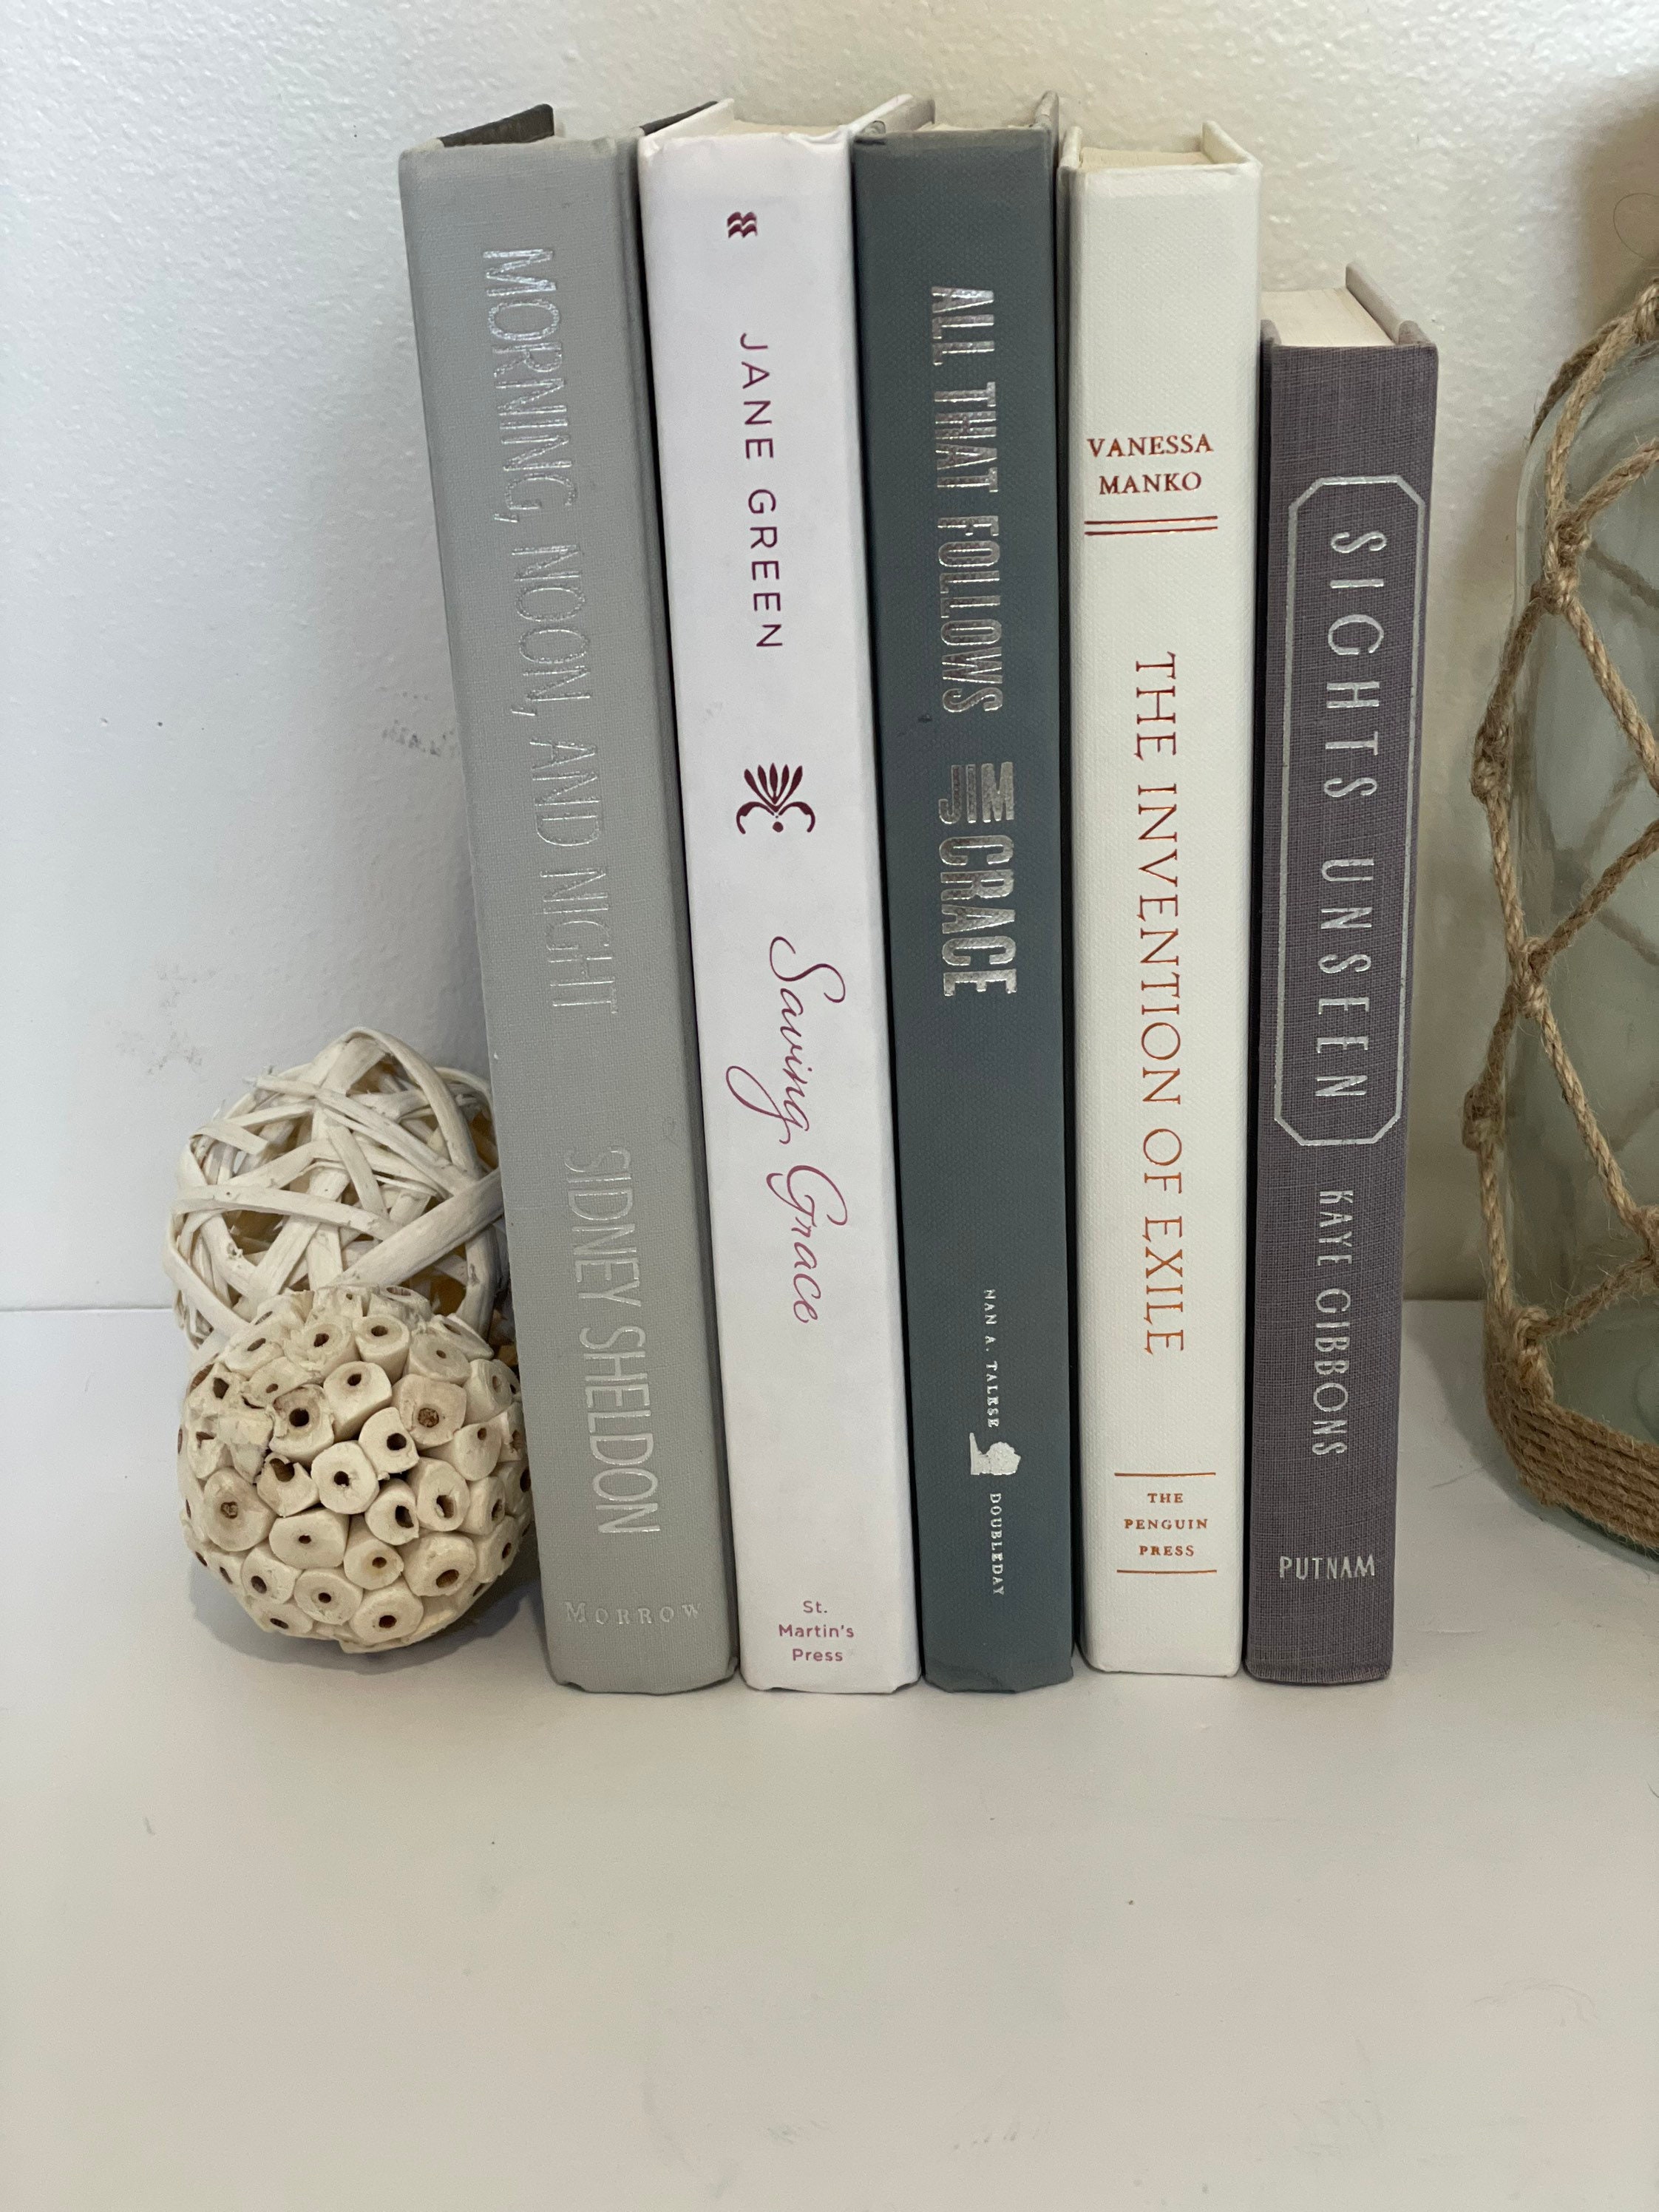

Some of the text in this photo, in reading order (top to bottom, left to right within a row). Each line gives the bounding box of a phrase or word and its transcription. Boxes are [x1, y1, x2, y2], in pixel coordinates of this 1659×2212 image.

[482, 248, 577, 523] MORNING,
[739, 332, 783, 648] JANE GREEN
[1087, 433, 1214, 458] VANESSA
[1099, 471, 1202, 495] MANKO
[932, 286, 1003, 713] ALL THAT FOLLOWS
[529, 739, 602, 847] AND
[1314, 531, 1387, 1097] SIGHTS UNSEEN
[938, 761, 1017, 997] JIM CRACE
[1135, 651, 1184, 1356] THE INVENTION OF EXILE
[726, 936, 848, 1323] Saving Grace
[564, 1146, 661, 1534] SIDNEY SHELDON
[983, 1289, 1000, 1428] NAN A. TALESE
[1312, 1190, 1354, 1456] KAYE GIBBONS
[989, 1492, 1004, 1596] DOUBLEDAY
[1124, 1519, 1209, 1530] PENGUIN
[1139, 1544, 1195, 1557] PRESS
[1147, 1493, 1184, 1504] THE
[564, 1601, 702, 1626] MORROW
[802, 1600, 828, 1615] St.
[1279, 1554, 1376, 1581] PUTNAM
[778, 1624, 855, 1639] Martin's
[792, 1648, 844, 1663] Press
